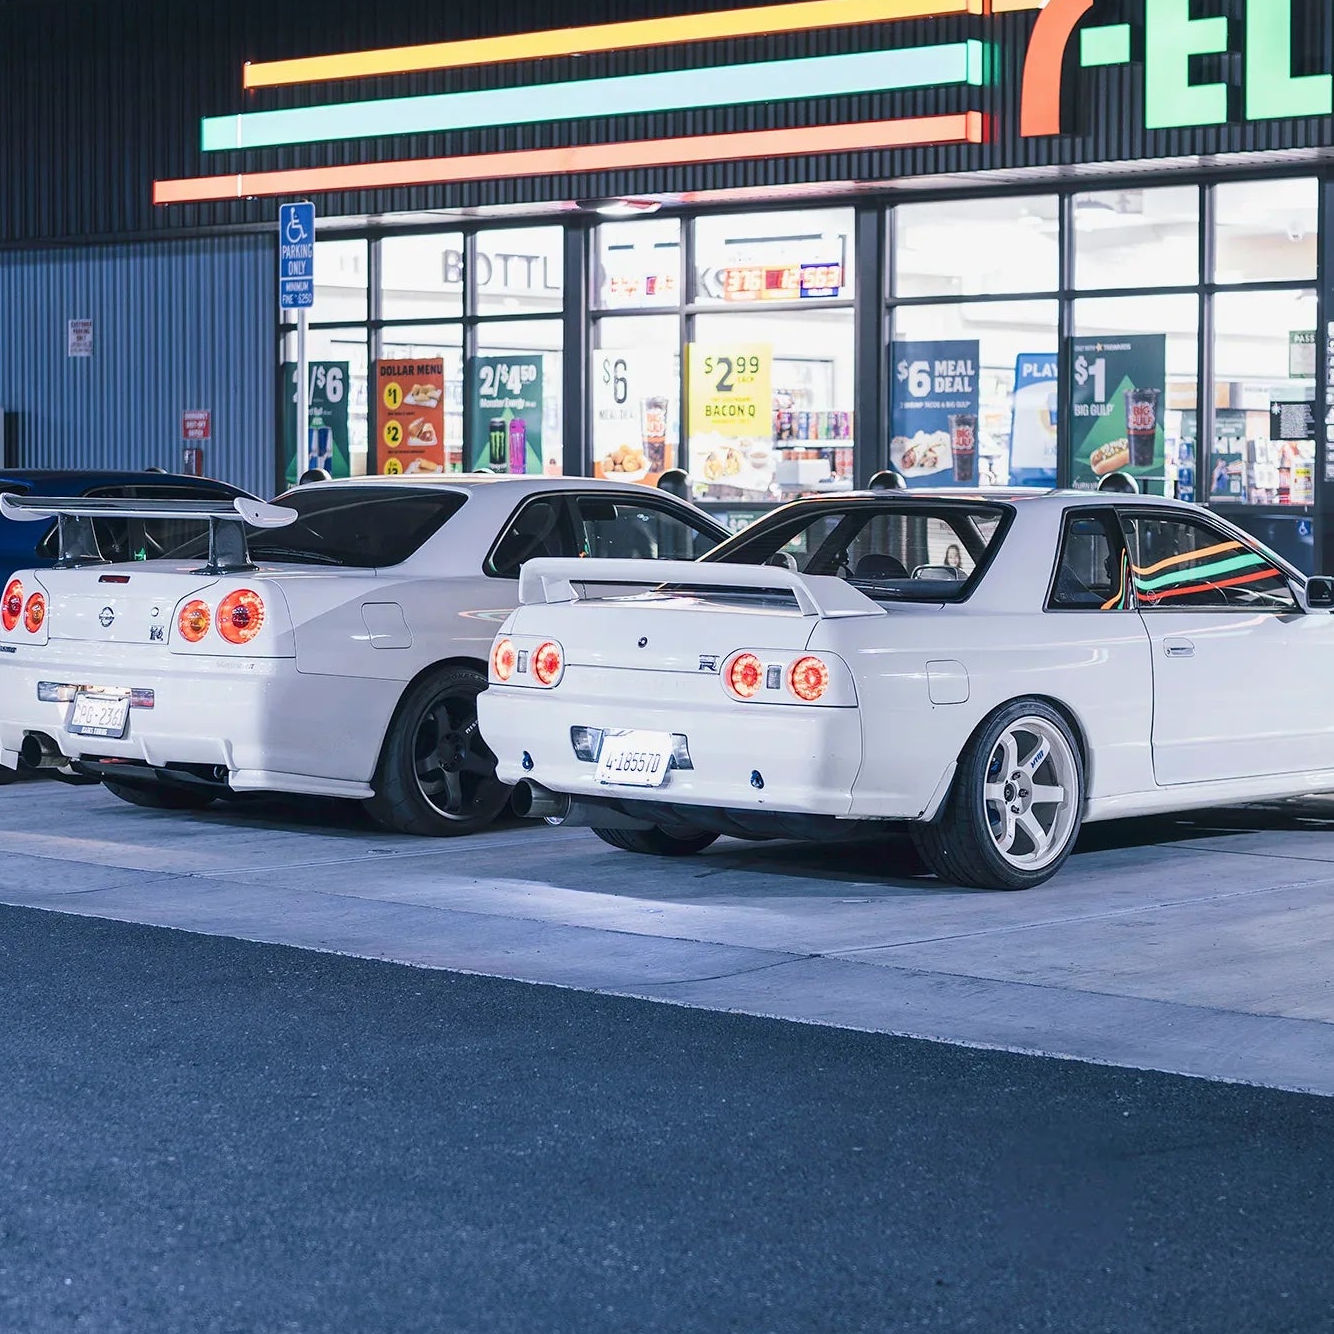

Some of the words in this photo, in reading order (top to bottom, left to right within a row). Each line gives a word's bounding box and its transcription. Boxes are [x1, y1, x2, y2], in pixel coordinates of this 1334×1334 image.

[282, 244, 313, 259] PARKING
[288, 260, 306, 275] ONLY
[442, 249, 561, 289] BOTTL
[285, 282, 308, 292] MINIMUM
[1294, 334, 1315, 343] PASS
[380, 365, 414, 377] DOLLAR
[417, 364, 443, 375] MENU
[1022, 363, 1058, 377] PLAY
[603, 358, 627, 404] $6
[897, 360, 931, 398] $6
[934, 360, 975, 377] MEAL
[934, 376, 972, 394] DEAL
[1074, 355, 1105, 403] $1
[388, 388, 397, 404] $1
[705, 405, 745, 417] BACON
[1074, 405, 1088, 417] BIG
[1090, 404, 1114, 417] GULP
[387, 426, 400, 442] $2
